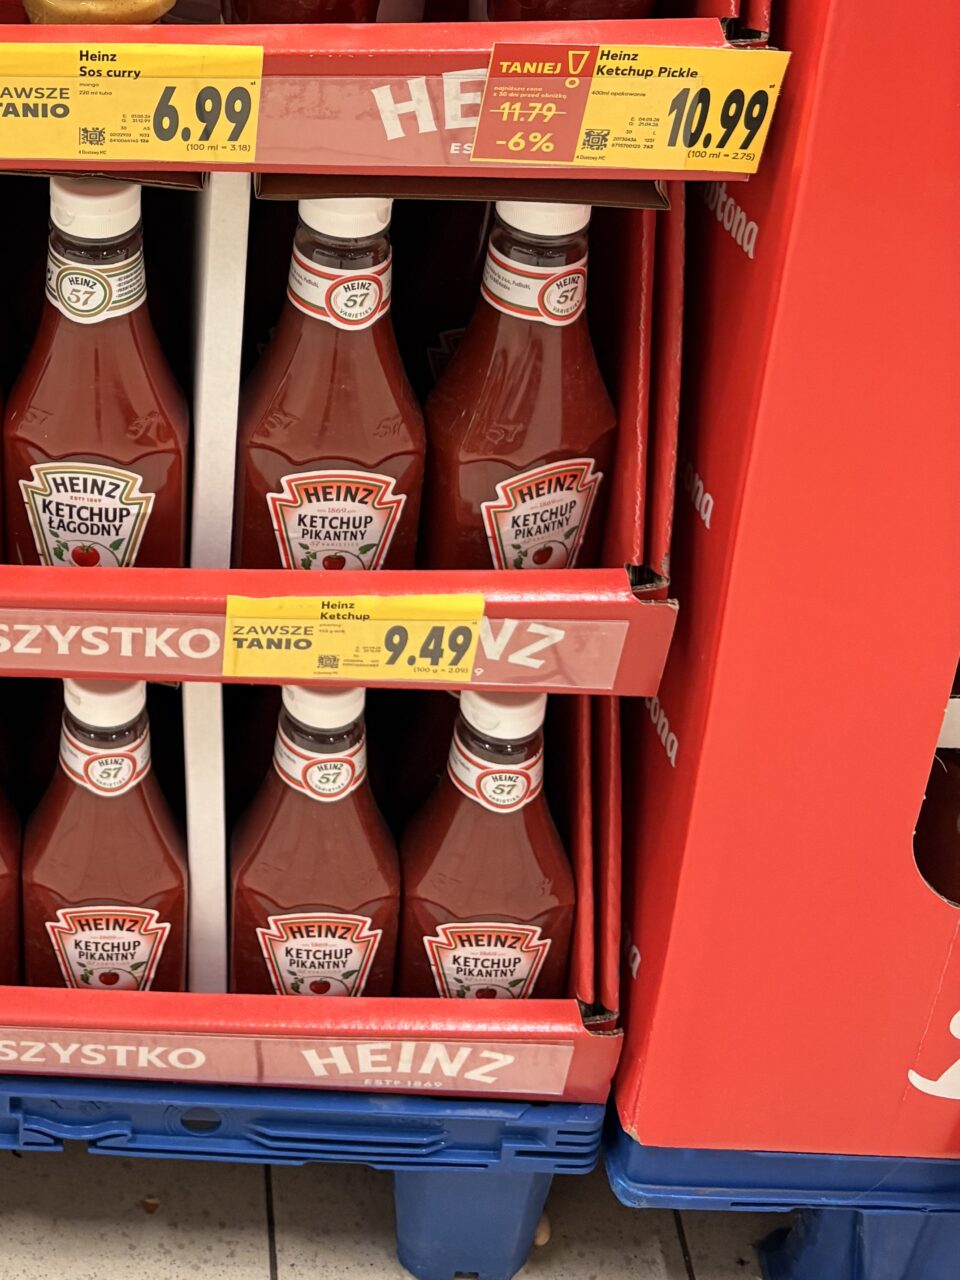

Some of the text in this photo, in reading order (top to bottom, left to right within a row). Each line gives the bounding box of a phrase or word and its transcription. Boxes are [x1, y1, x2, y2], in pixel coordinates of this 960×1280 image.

[79, 51, 117, 62] Heinz
[600, 50, 638, 61] Heinz
[79, 67, 141, 79] Sos curry
[499, 62, 562, 74] TANIEJ
[596, 66, 698, 79] Ketchup Pickle
[153, 86, 252, 142] 6.99
[499, 102, 557, 122] 11.79
[668, 88, 769, 150] 10.99
[230, 144, 251, 152] 3.18)
[496, 132, 554, 152] -6%
[687, 150, 706, 159] (100
[732, 152, 755, 161] 2.75)
[68, 276, 97, 289] HEINZ
[67, 288, 95, 305] 57
[51, 476, 121, 499] HEINZ
[518, 474, 579, 504] HEINZ
[304, 486, 375, 506] HEINZ
[41, 500, 131, 522] KETCHUP
[511, 499, 577, 528] KETCHUP
[47, 520, 123, 537] ŁAGODNY
[297, 514, 373, 530] KETCHUP
[514, 516, 572, 539] PIKANTNY
[301, 528, 367, 541] PIKANTNY
[322, 601, 355, 609] Heinz
[320, 613, 370, 621] Ketchup
[233, 626, 314, 636] ZAWSZE
[233, 638, 312, 650] TANIO
[384, 625, 472, 666] 9.49
[77, 916, 140, 934] HEINZ
[74, 940, 142, 952] KETCHUP
[457, 934, 523, 950] HEINZ
[78, 950, 136, 961] PIKANTNY
[452, 955, 522, 969] KETCHUP
[456, 966, 516, 978] PIKANTNY
[300, 1041, 516, 1084] HEINZ
